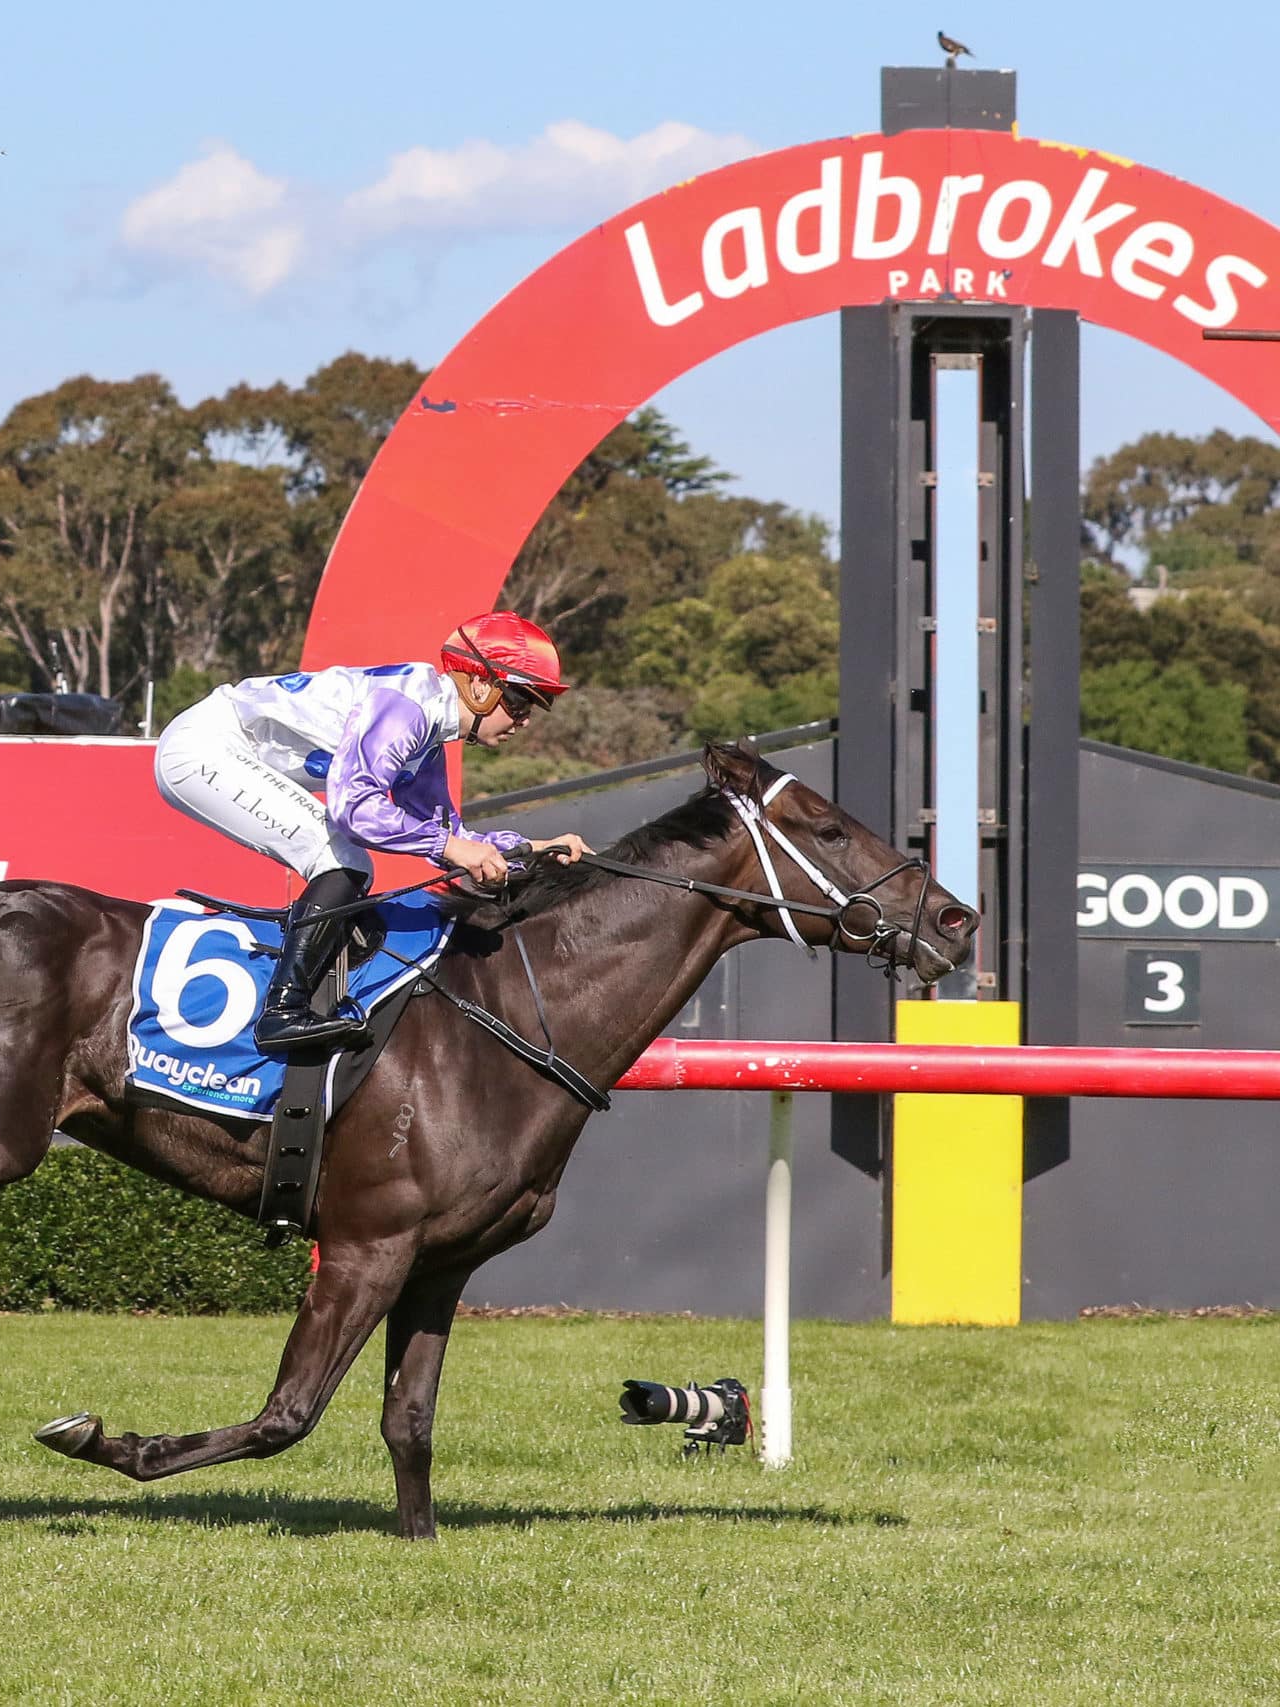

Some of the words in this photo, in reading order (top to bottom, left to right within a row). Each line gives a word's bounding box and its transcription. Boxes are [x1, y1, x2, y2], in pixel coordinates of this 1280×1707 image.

[624, 151, 1267, 327] Ladbrokes
[889, 267, 1008, 297] PARK
[236, 754, 263, 771] OFF
[263, 771, 289, 792] THE
[232, 788, 301, 840] Lloyd
[1077, 872, 1269, 929] GOOD
[151, 919, 257, 1048] 6
[1144, 960, 1186, 1013] 3
[182, 1082, 230, 1101] Experience
